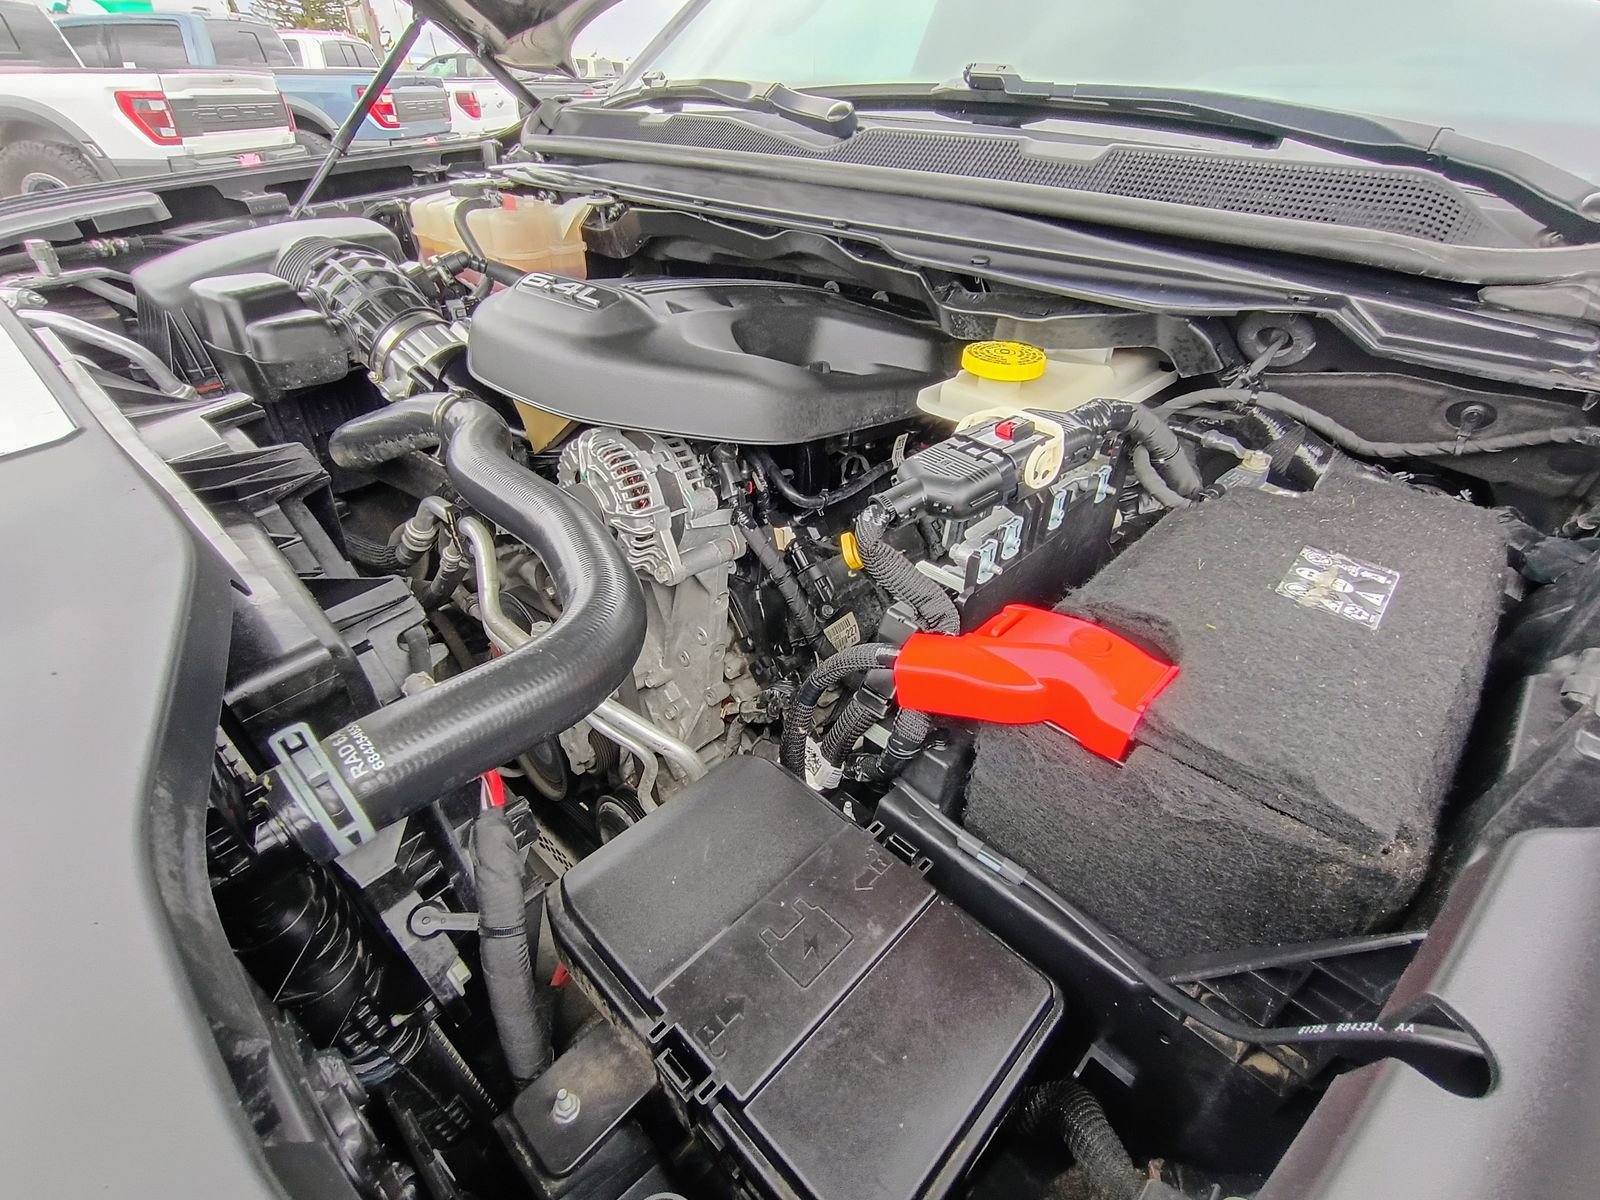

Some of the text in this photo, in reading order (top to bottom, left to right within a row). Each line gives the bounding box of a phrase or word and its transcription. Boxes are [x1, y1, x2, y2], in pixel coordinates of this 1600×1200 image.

[520, 273, 600, 308] 6.4L
[338, 744, 369, 779] RAD
[1395, 1022, 1414, 1033] AA
